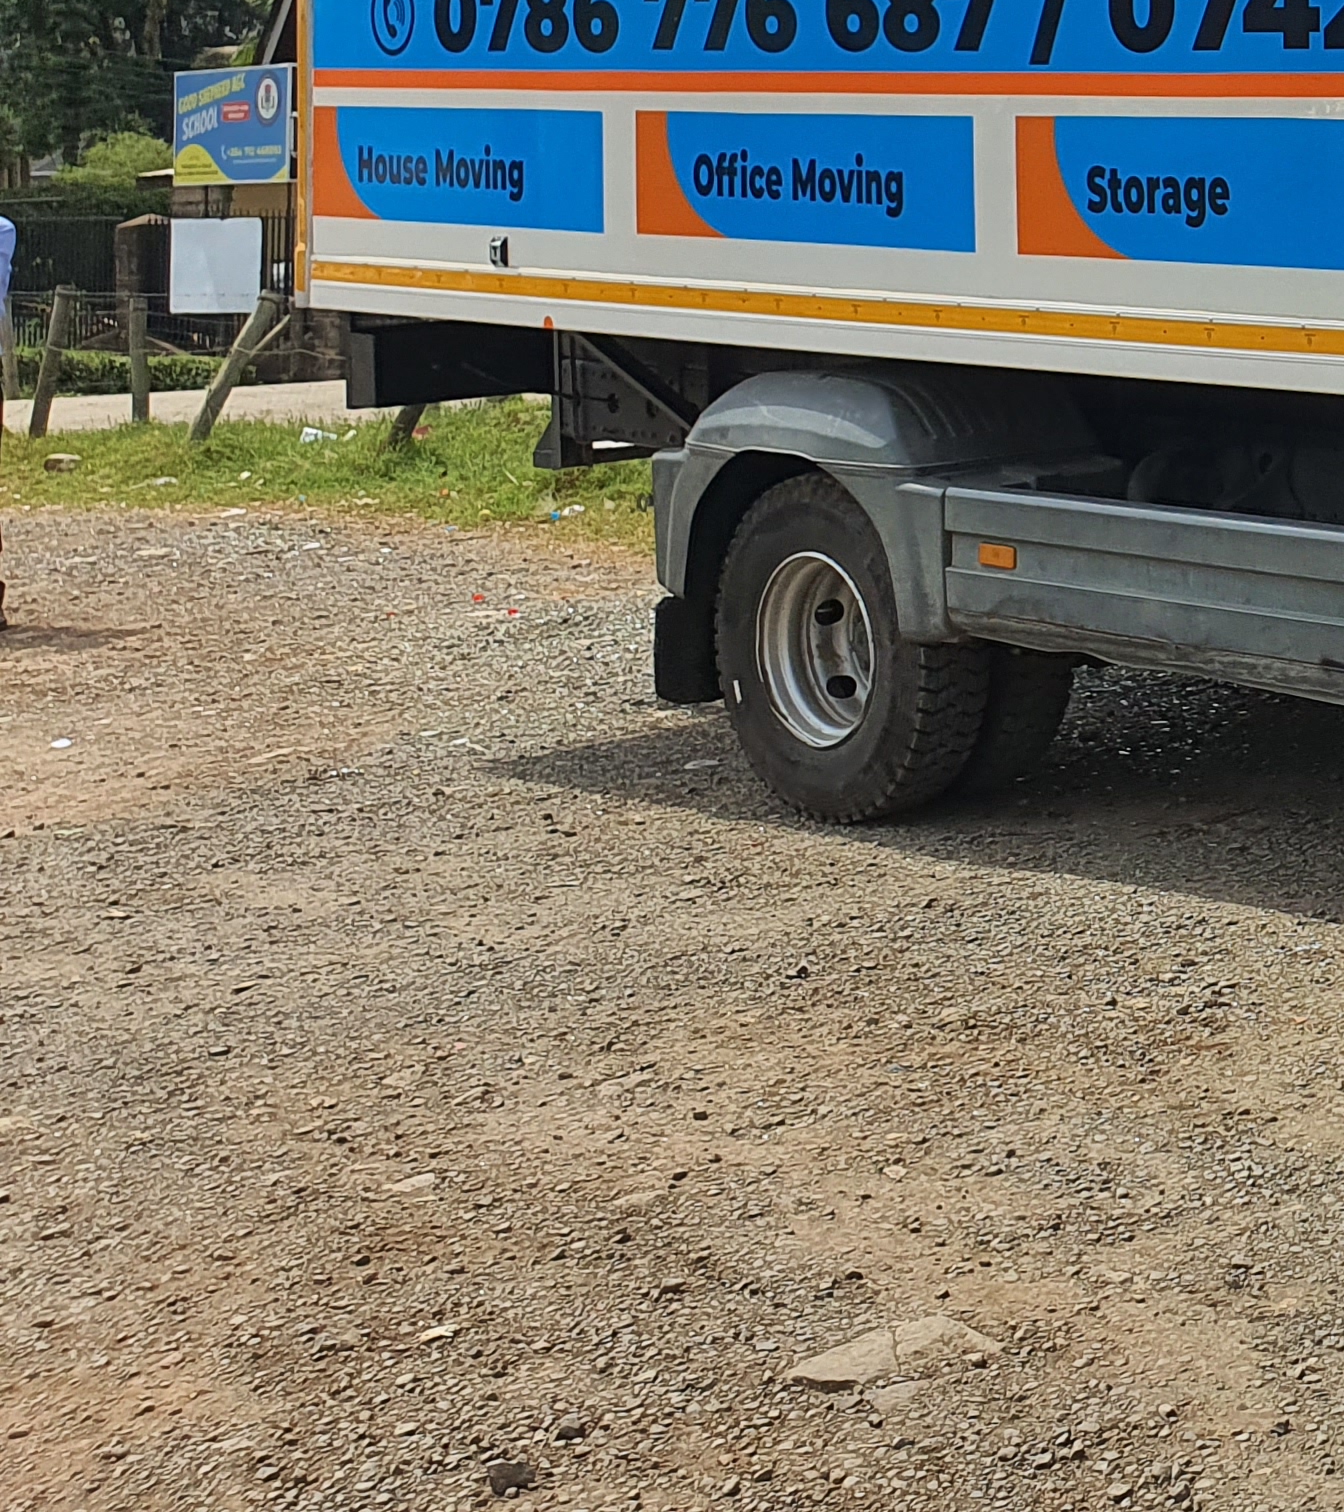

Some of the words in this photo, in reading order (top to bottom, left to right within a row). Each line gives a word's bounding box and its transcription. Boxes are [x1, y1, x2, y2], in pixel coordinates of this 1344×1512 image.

[182, 106, 218, 141] SCHOOL
[356, 144, 427, 190] House
[434, 144, 525, 203] Moving
[692, 148, 783, 201] Office
[791, 152, 905, 219] Moving
[1086, 164, 1231, 229] Storage
